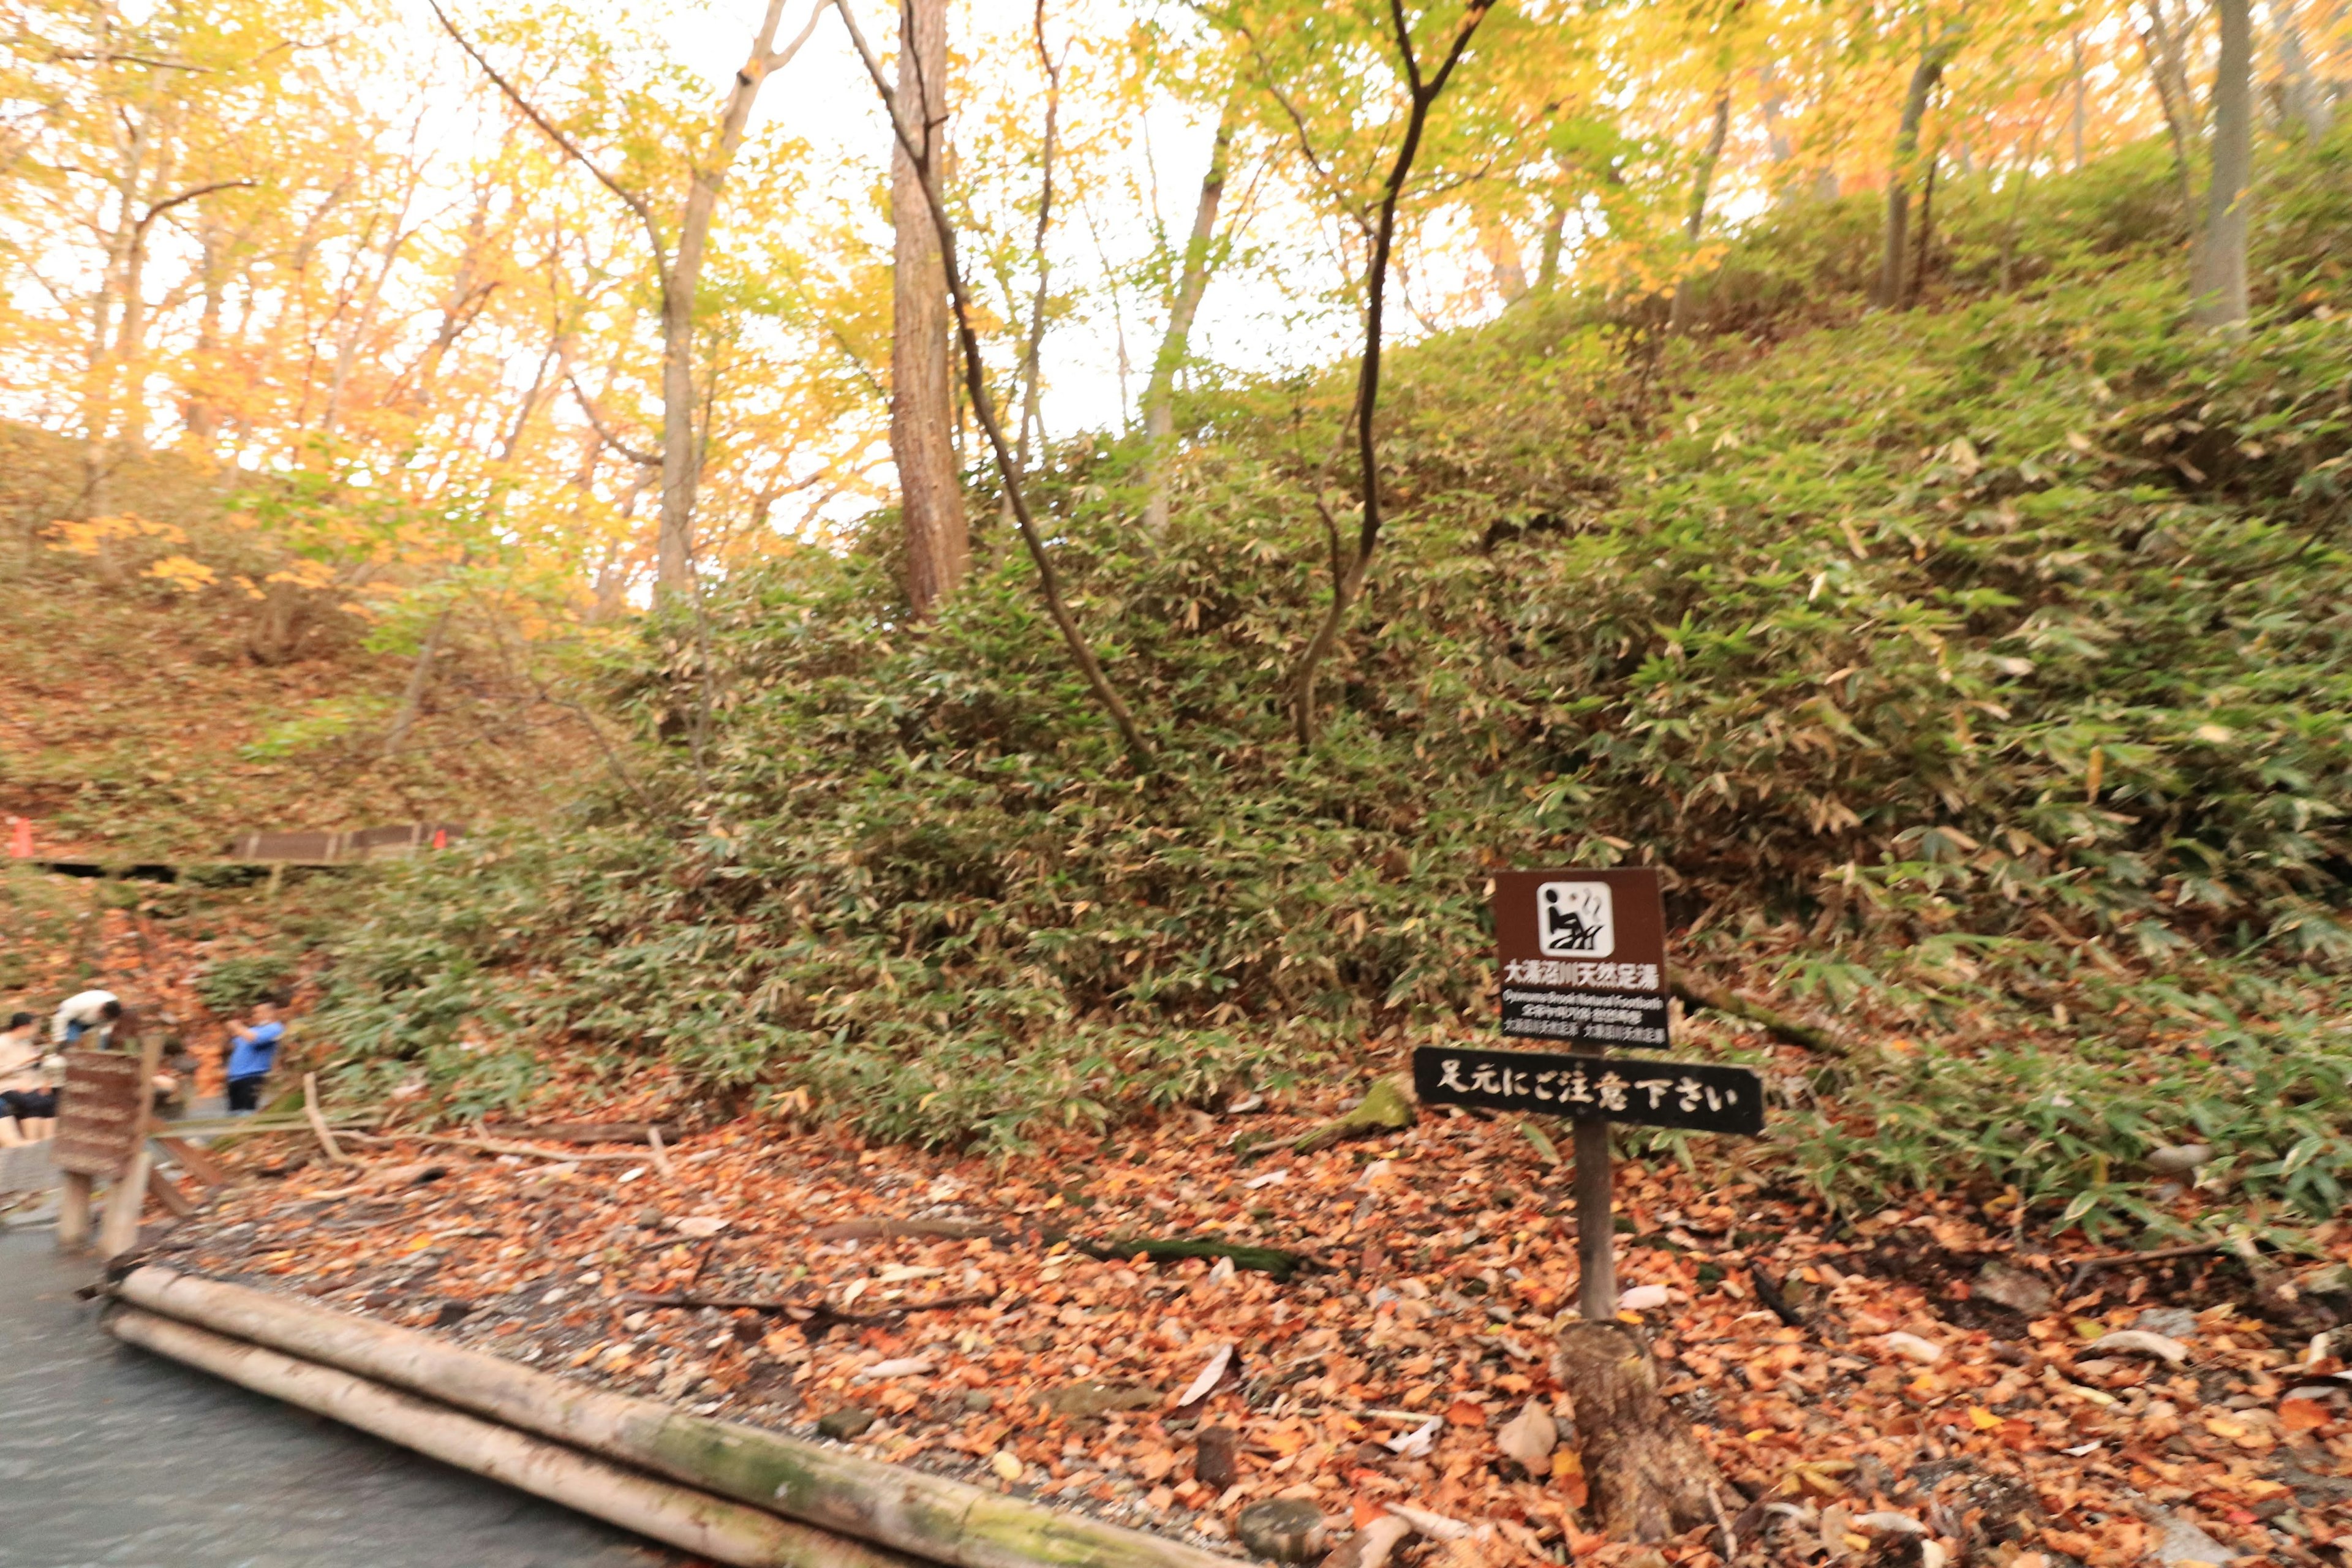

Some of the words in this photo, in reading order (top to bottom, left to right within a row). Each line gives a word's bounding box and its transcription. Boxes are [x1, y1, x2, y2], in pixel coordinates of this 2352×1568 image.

[1504, 958, 1659, 990] 大湯沼川天然足湯
[1437, 1058, 1738, 1113] 足元にご注意下さい
